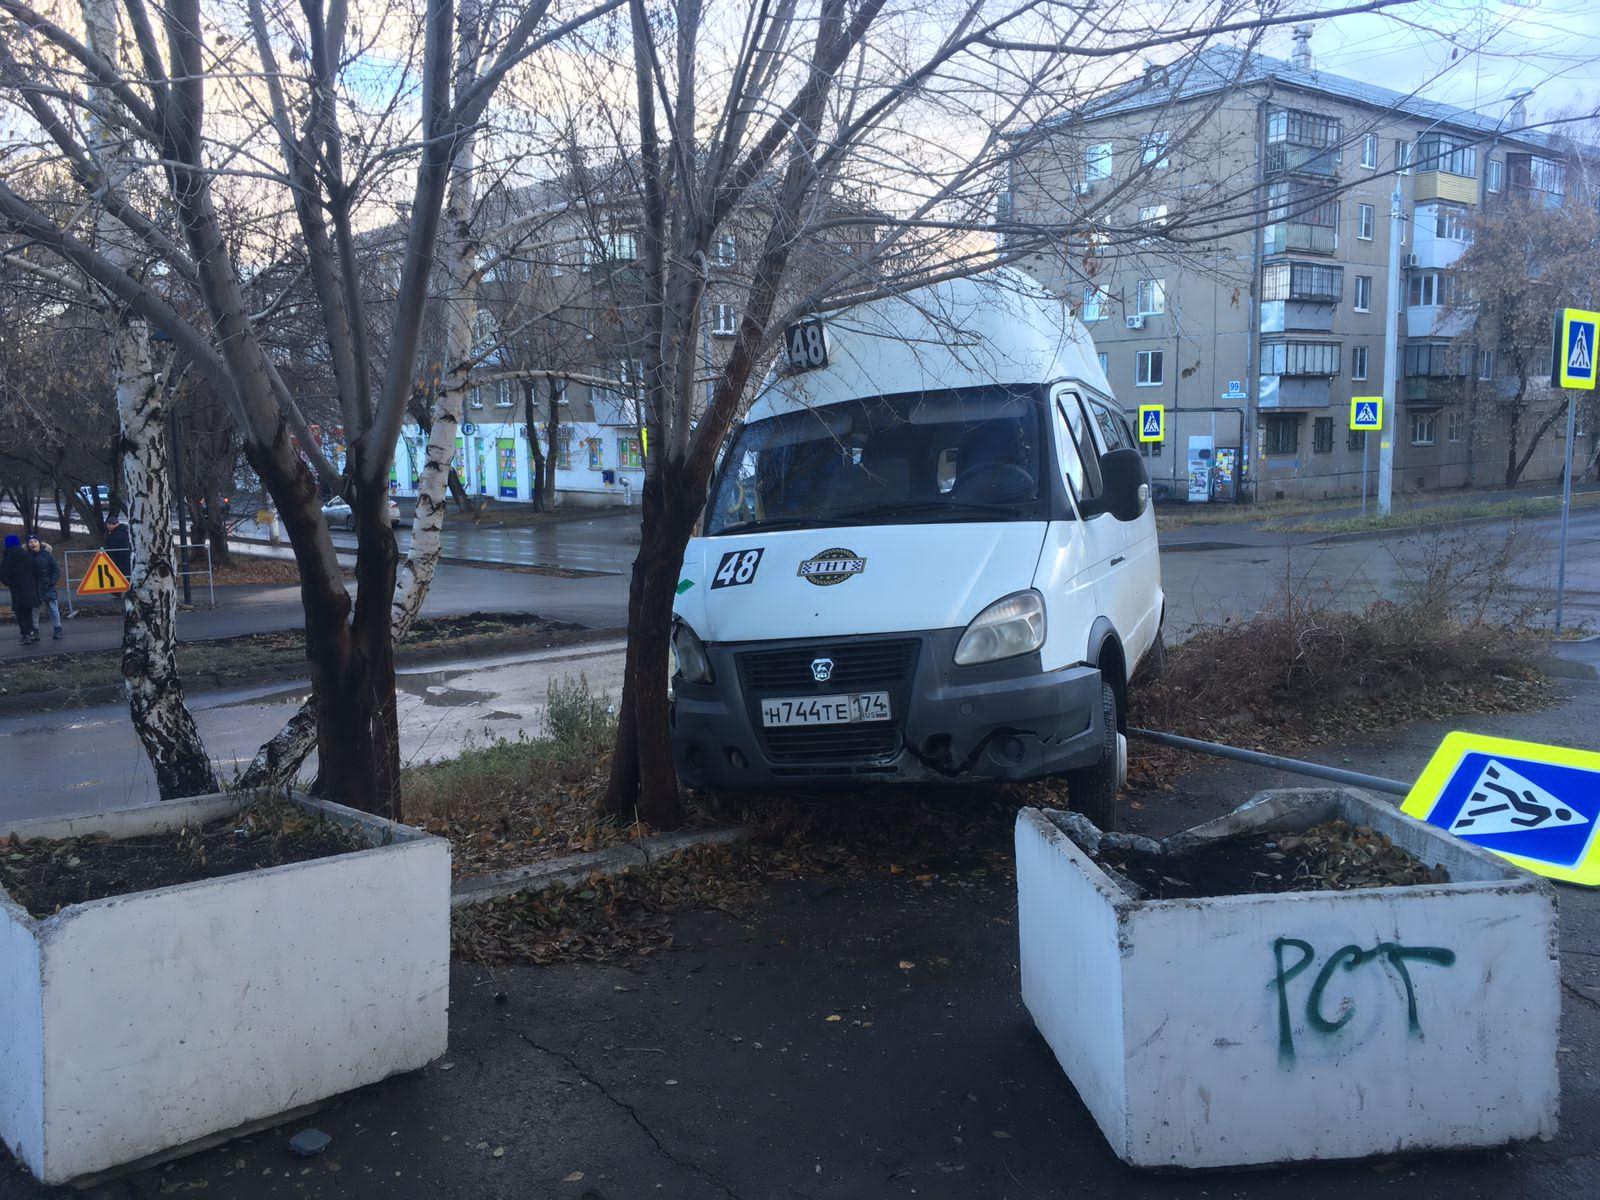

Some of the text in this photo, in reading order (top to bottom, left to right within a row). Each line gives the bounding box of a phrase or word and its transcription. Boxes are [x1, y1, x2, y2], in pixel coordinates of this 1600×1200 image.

[791, 325, 825, 369] 48
[716, 550, 760, 585] 48
[769, 701, 849, 723] Н744ТЕ
